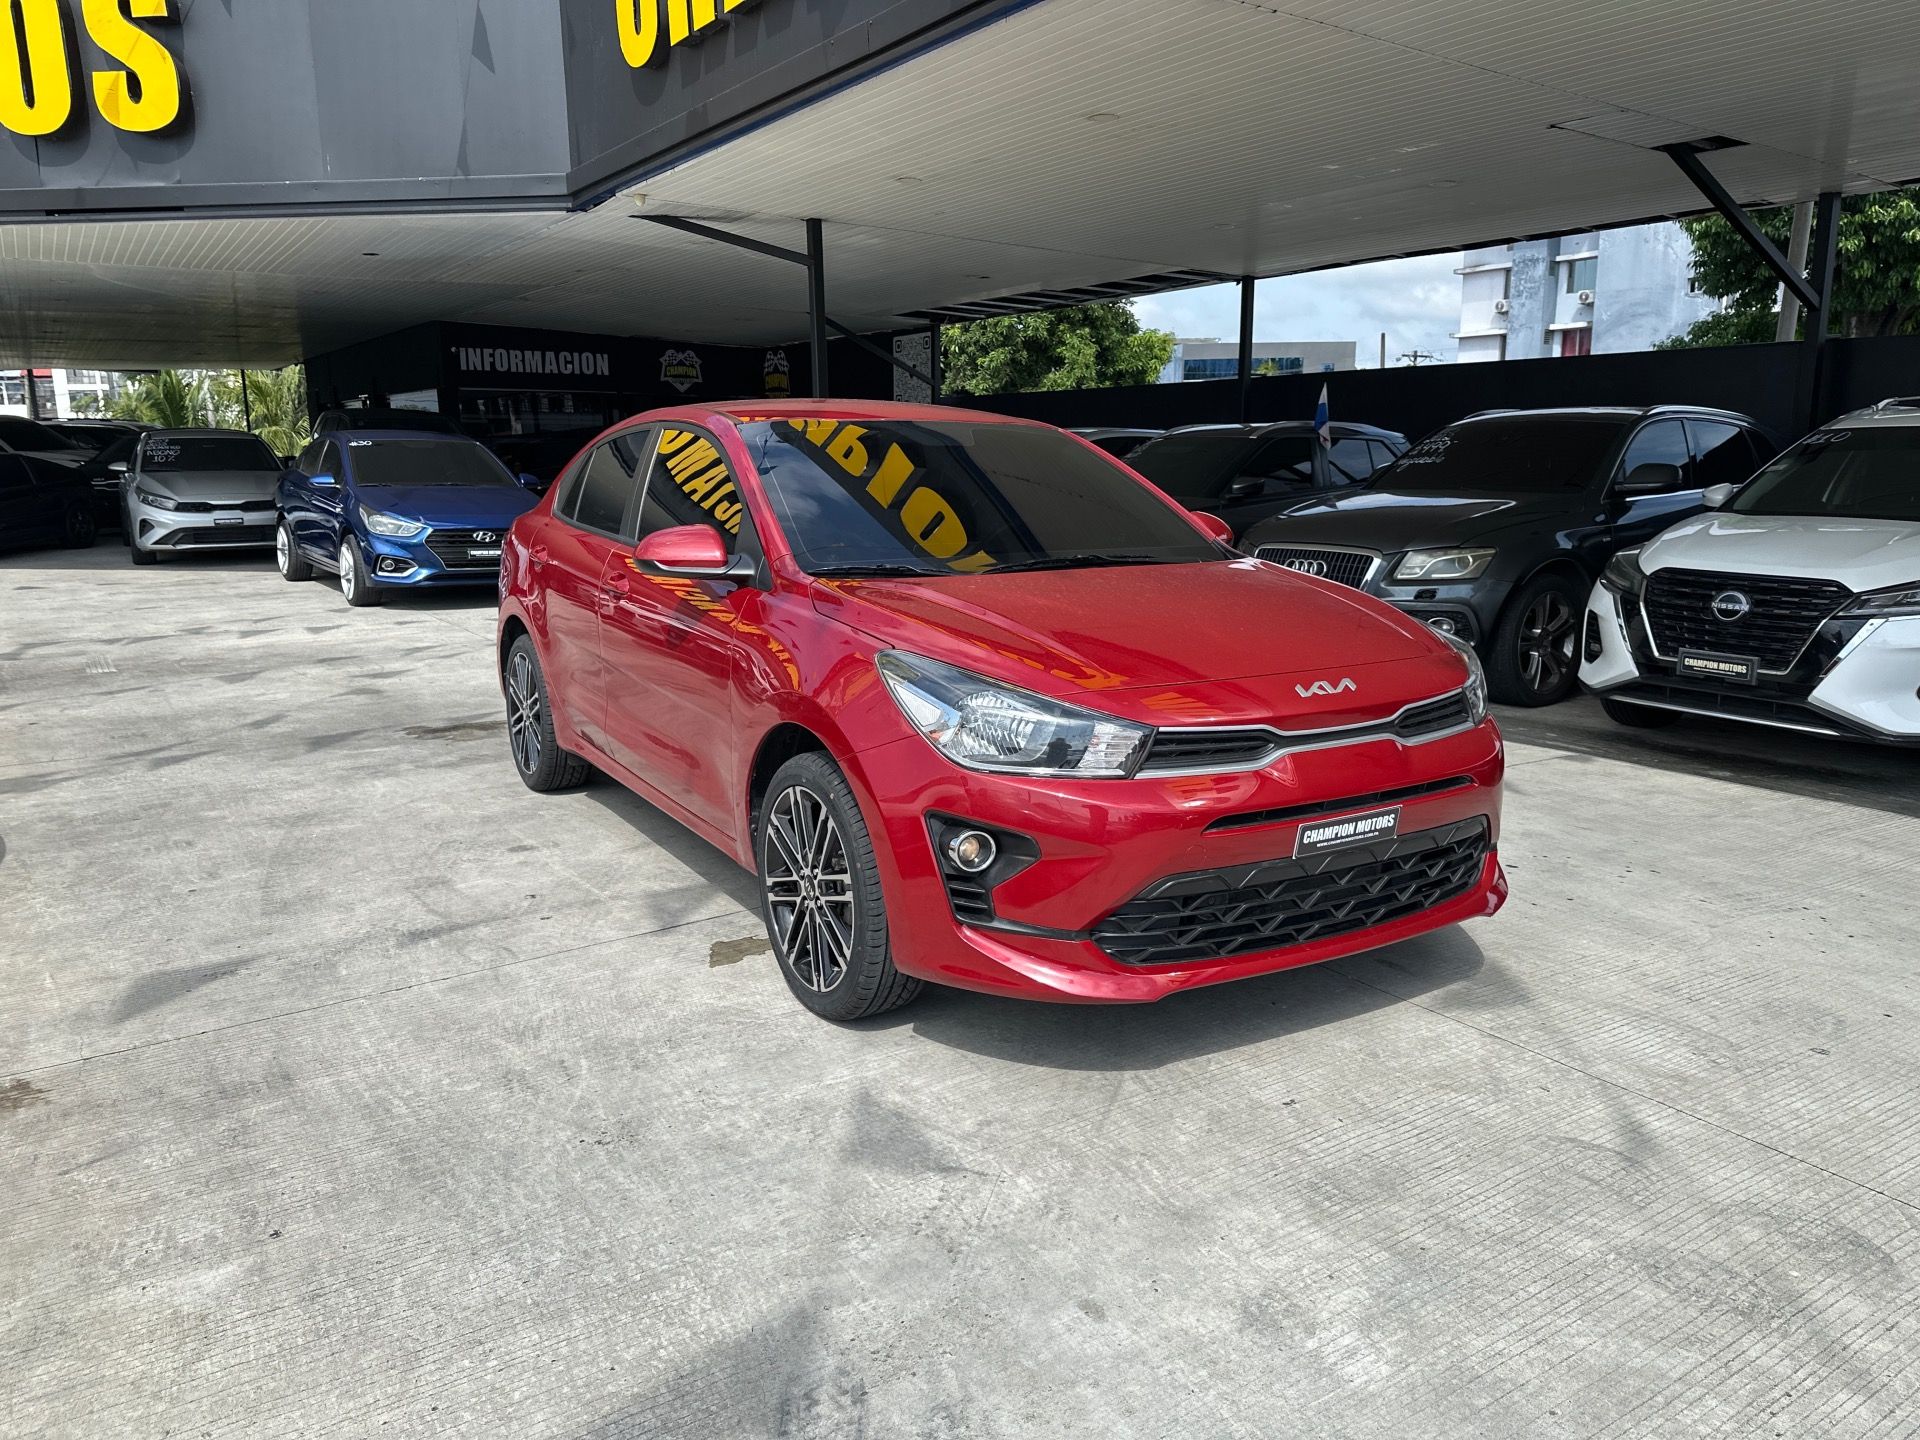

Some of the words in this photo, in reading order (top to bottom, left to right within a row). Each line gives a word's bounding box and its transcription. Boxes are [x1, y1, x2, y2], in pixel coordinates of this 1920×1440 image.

[459, 347, 610, 376] INFORMACION
[1711, 601, 1750, 612] NISSAN
[1684, 657, 1719, 670] CHAMPION
[1718, 662, 1748, 674] MOTORS
[1294, 677, 1357, 698] KIA
[1302, 822, 1356, 844] CHAMPION
[1355, 813, 1396, 834] MOTORS
